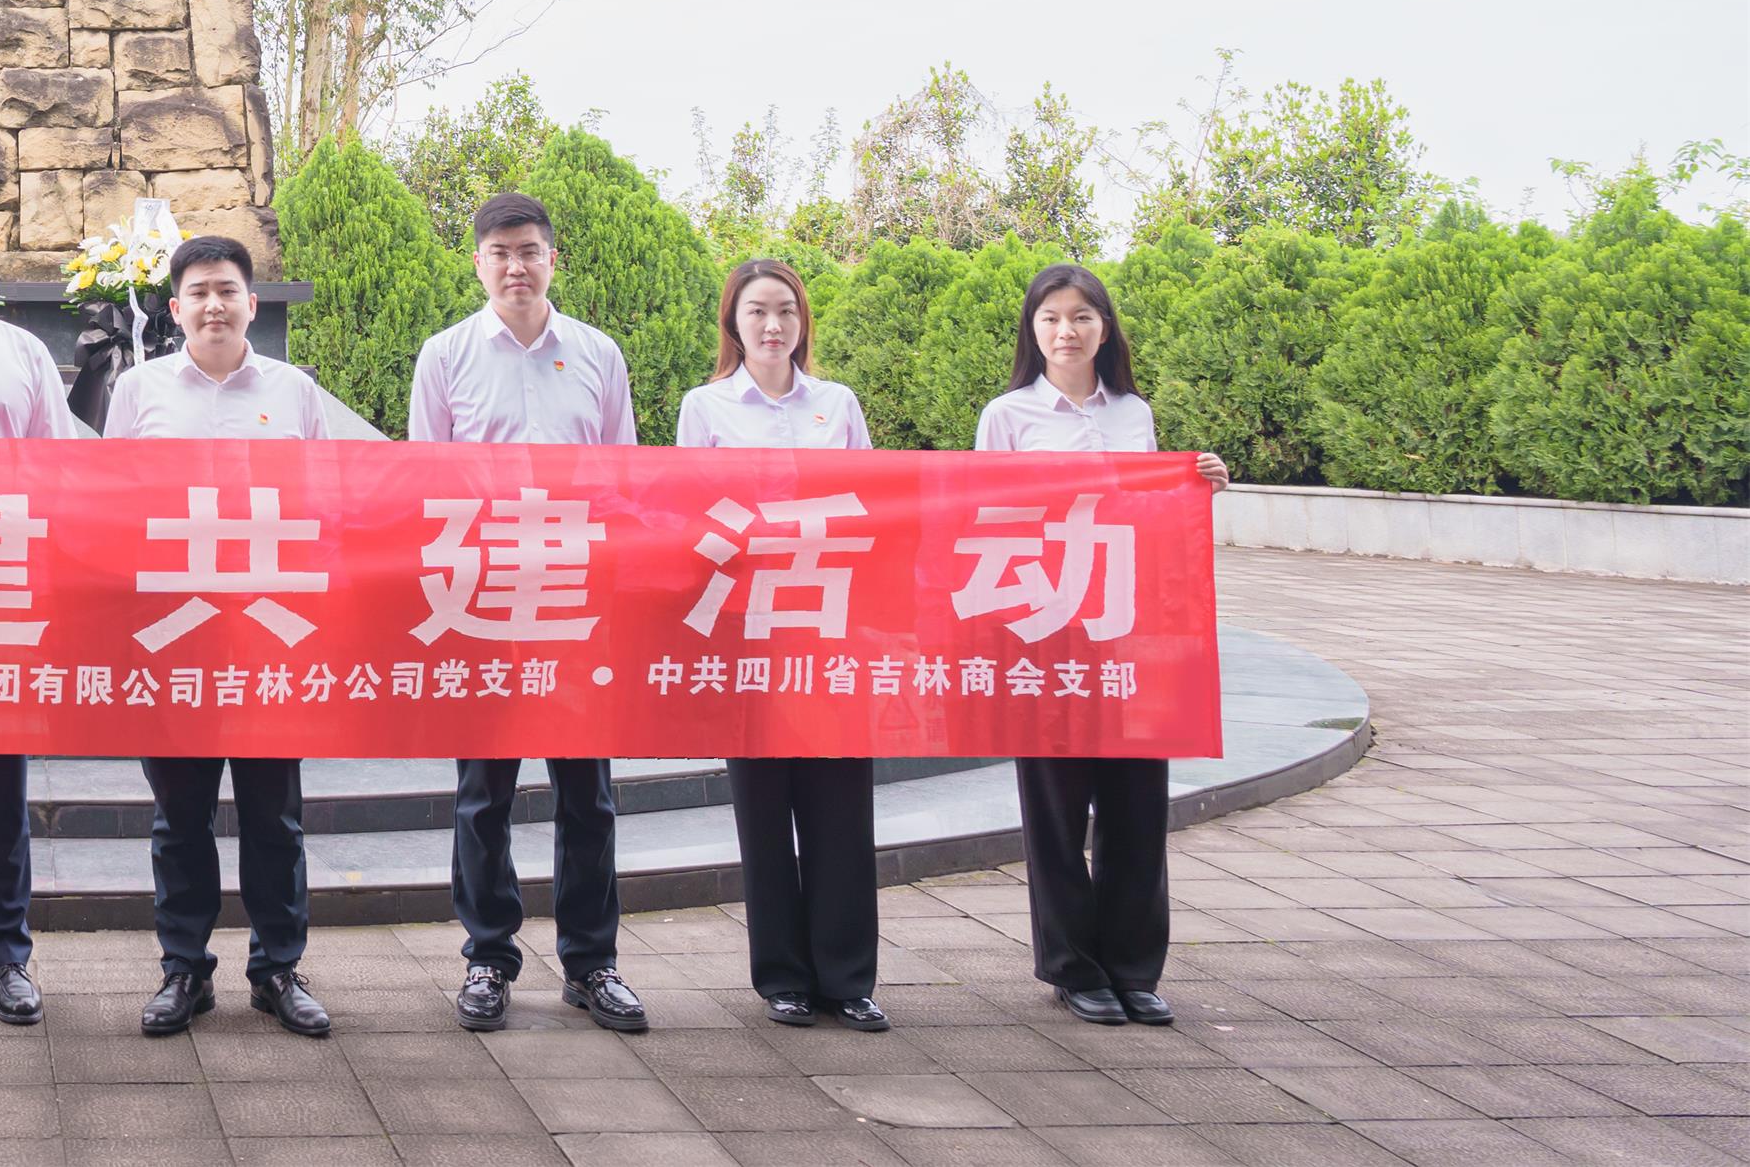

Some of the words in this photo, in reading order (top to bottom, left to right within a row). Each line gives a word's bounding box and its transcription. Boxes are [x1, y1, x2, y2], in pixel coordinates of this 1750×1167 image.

[646, 653, 1138, 701] 中共四川省吉林商会支部
